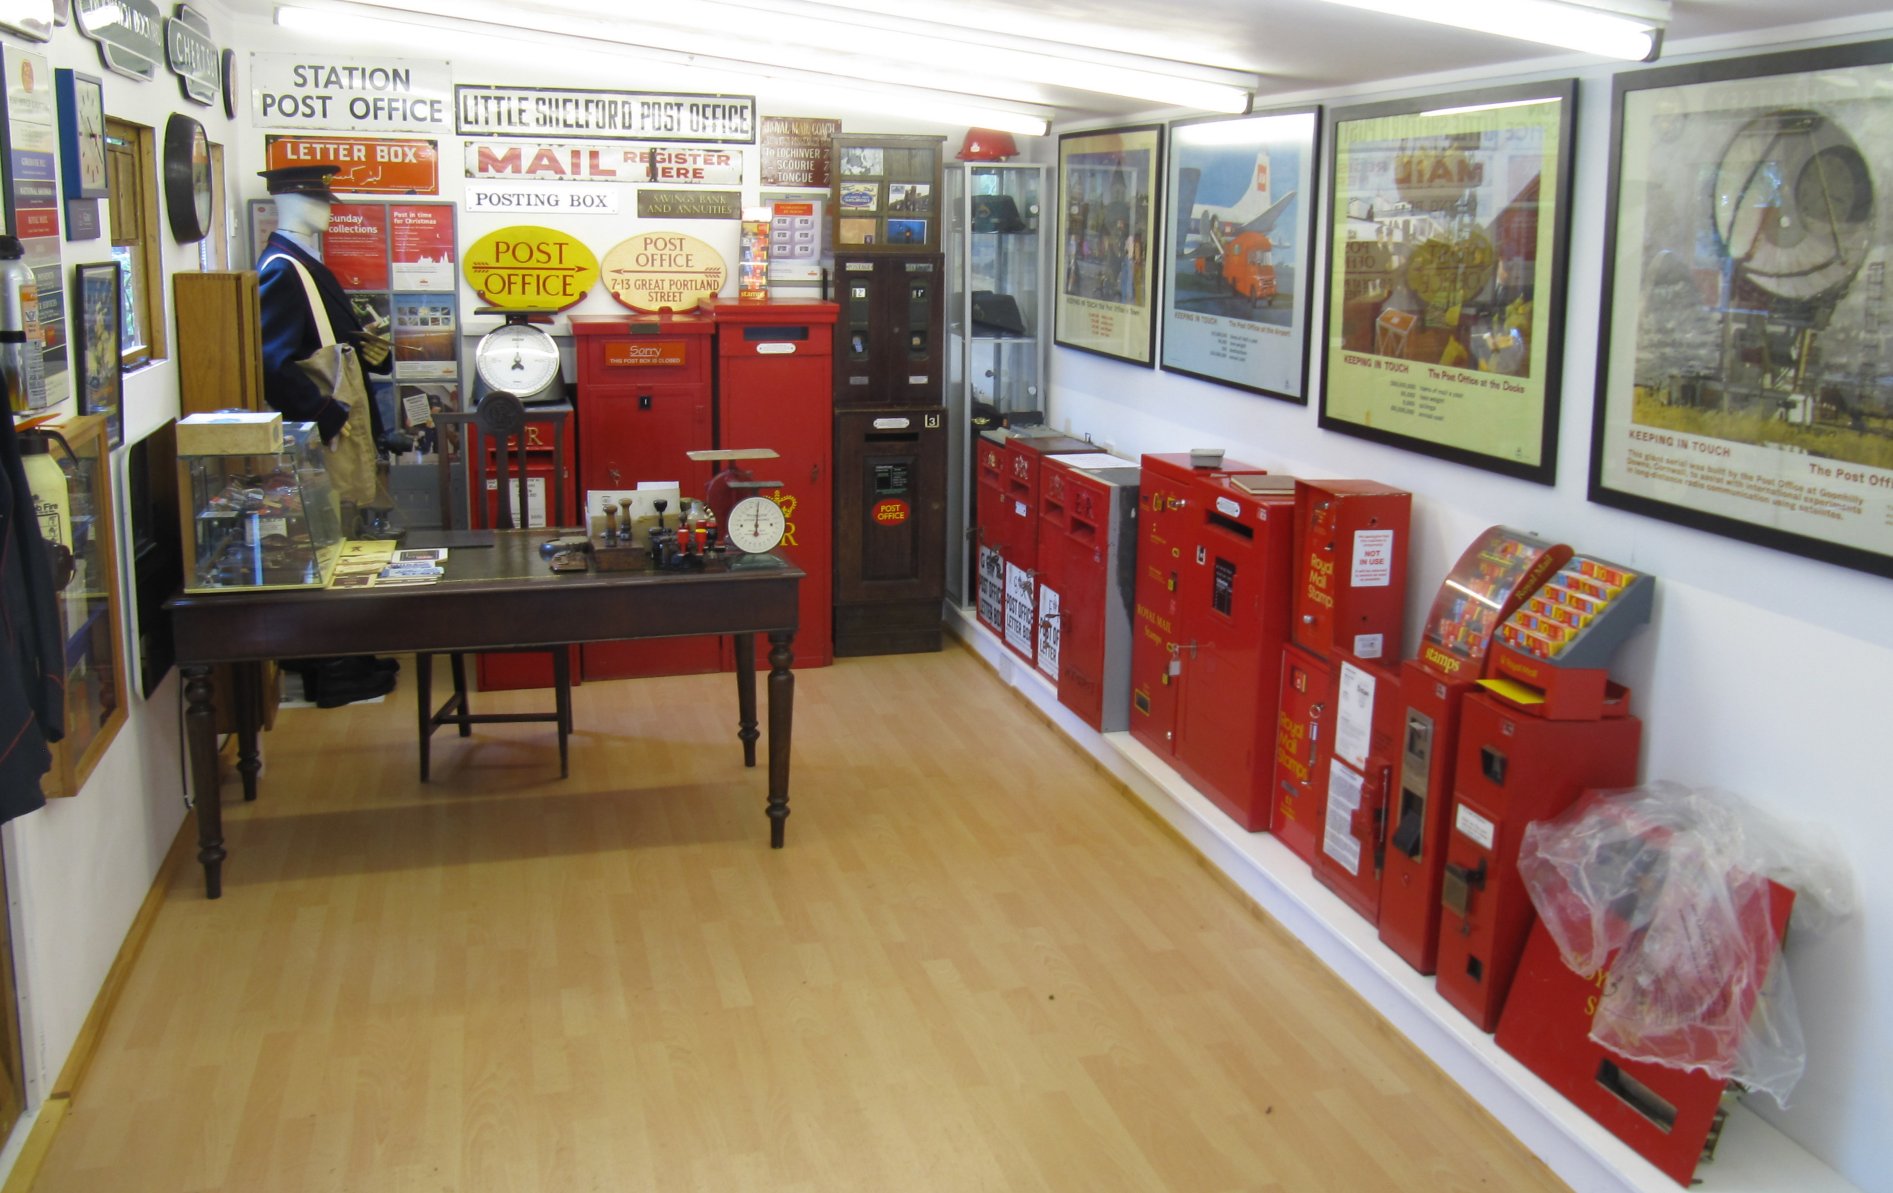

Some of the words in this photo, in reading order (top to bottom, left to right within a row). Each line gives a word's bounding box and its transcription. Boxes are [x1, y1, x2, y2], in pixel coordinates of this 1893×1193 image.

[293, 64, 410, 92] STATION
[262, 93, 333, 118] POST
[349, 97, 443, 123] OFFICE
[464, 94, 530, 127] LITTLE
[536, 96, 632, 130] SHELFORD
[641, 101, 684, 132] POST
[689, 103, 749, 135] OFFICE
[286, 142, 367, 162] LETTER
[376, 146, 418, 164] BOX
[477, 146, 617, 177] MAIL
[623, 151, 731, 166] REGISTER
[776, 148, 820, 159] LOCHINVER
[777, 160, 815, 170] SCOURIE
[778, 172, 814, 183] TONGUE
[475, 192, 560, 208] POSTING
[570, 194, 608, 209] BOX
[700, 194, 727, 204] BANK
[647, 204, 672, 214] AND
[677, 205, 732, 214] ANNUITIES
[329, 214, 363, 224] Sunday
[328, 225, 378, 234] collections
[494, 241, 569, 265] POST
[643, 237, 686, 252] POST
[635, 253, 694, 268] OFFICE
[484, 273, 575, 297] OFFICE
[611, 278, 631, 290] 7-13
[634, 278, 666, 290] GREAT
[668, 278, 720, 292] PORTLAND
[648, 291, 683, 302] STREET
[630, 346, 662, 358] Sorry
[1344, 354, 1372, 368] KEEPING
[1374, 361, 1382, 370] IN
[1385, 362, 1409, 374] TOUCH
[1428, 368, 1440, 380] The
[1442, 371, 1456, 382] Post
[1458, 373, 1478, 386] Office
[1490, 380, 1500, 390] the
[1502, 381, 1526, 394] Docks
[928, 418, 936, 426] 3
[525, 426, 543, 446] R
[1628, 429, 1674, 447] KEEPING
[1677, 438, 1688, 449] IN
[1692, 440, 1731, 458] TOUCH
[1728, 470, 1738, 480] by
[1756, 475, 1776, 486] Post
[1778, 479, 1804, 493] Office
[1809, 463, 1832, 477] The
[1836, 468, 1865, 484] Post
[878, 512, 904, 520] OFFICE
[880, 504, 901, 512] POST
[780, 522, 799, 546] R
[1311, 553, 1334, 576] Royal
[1309, 571, 1327, 589] Mail
[1006, 614, 1022, 636] LETTER
[1425, 647, 1460, 674] stamps
